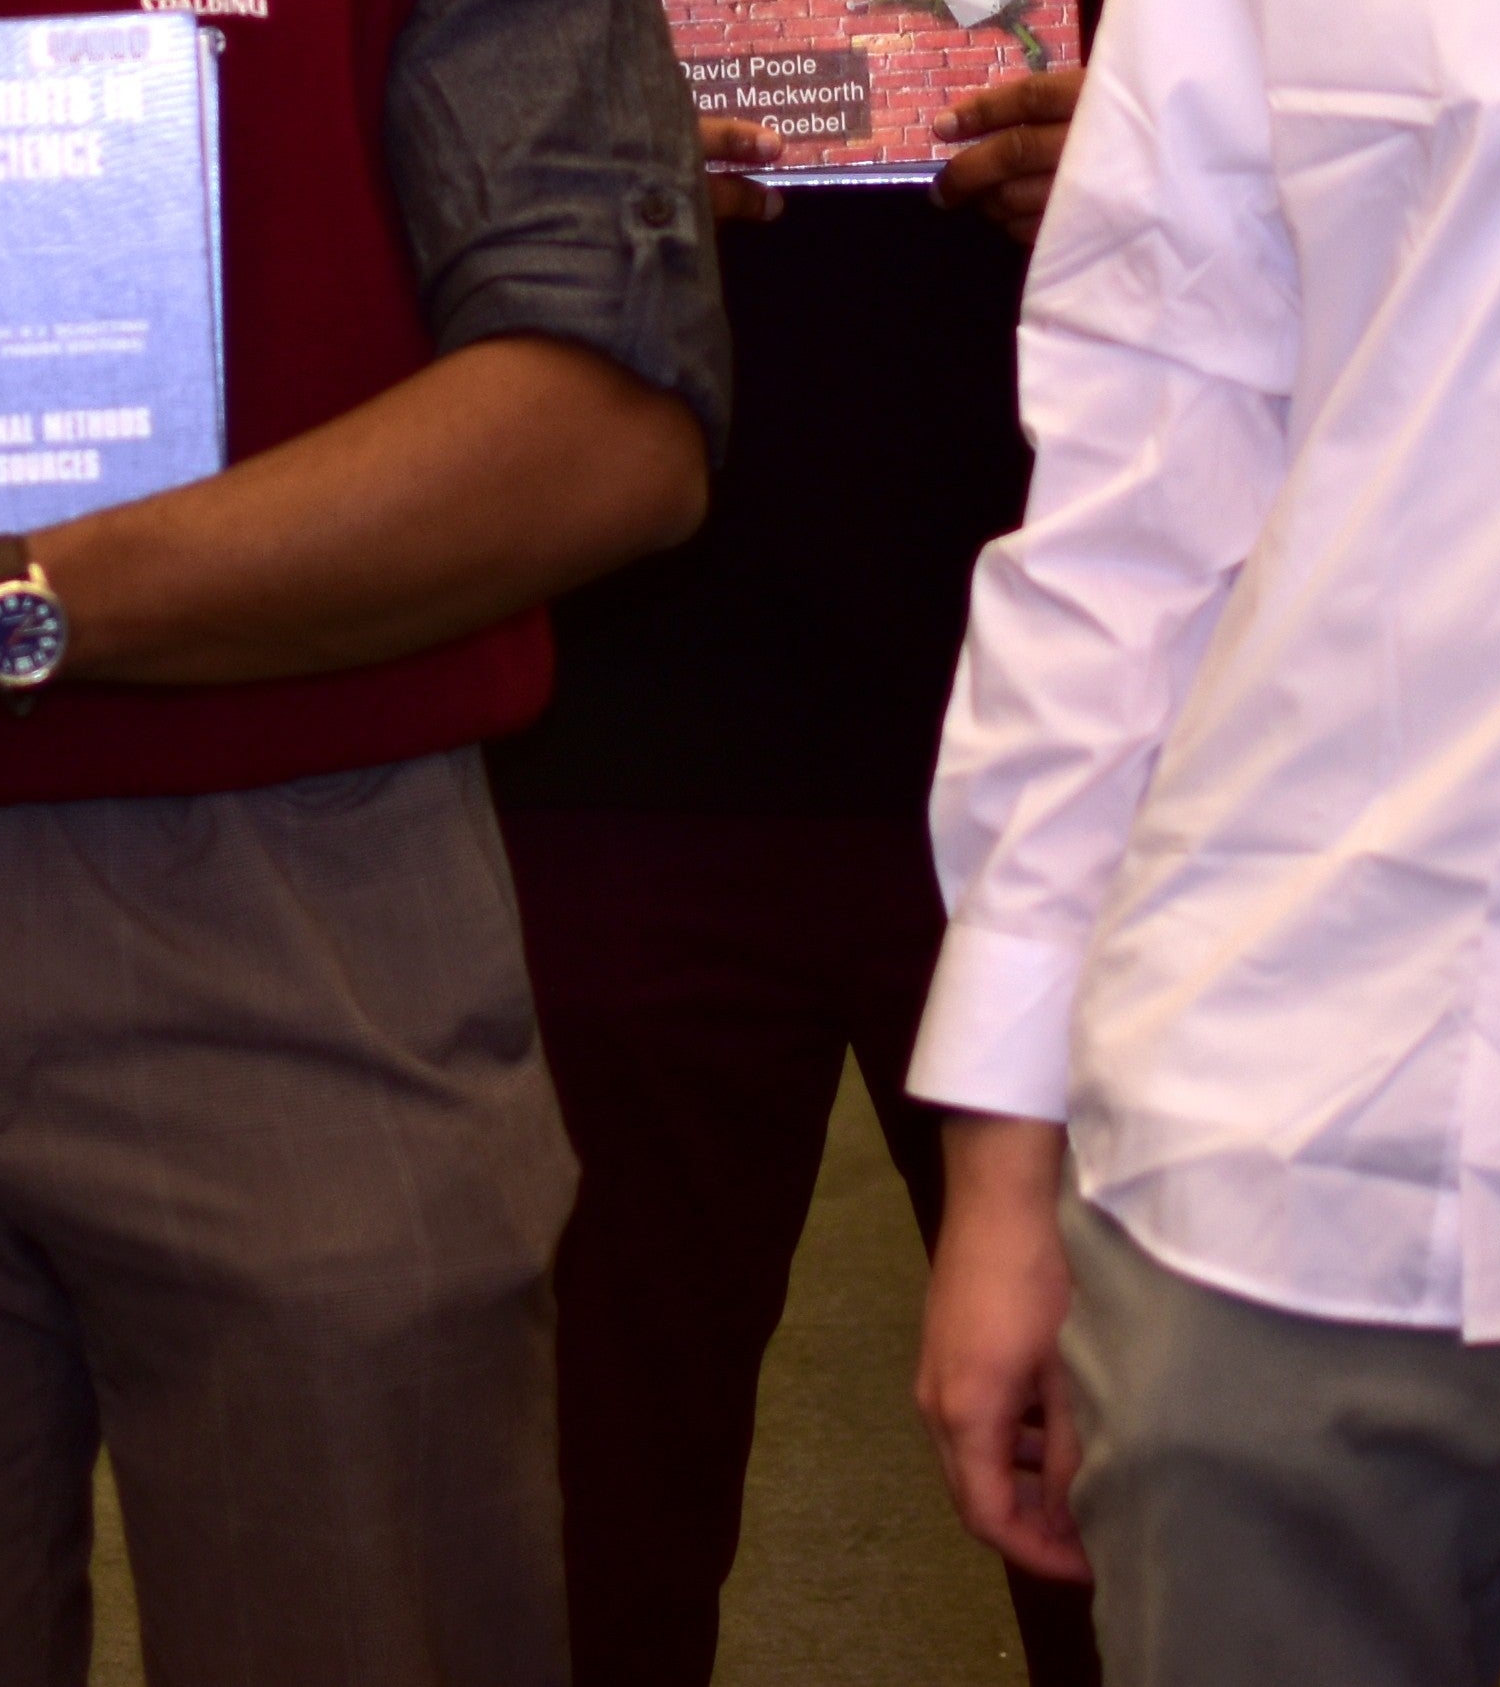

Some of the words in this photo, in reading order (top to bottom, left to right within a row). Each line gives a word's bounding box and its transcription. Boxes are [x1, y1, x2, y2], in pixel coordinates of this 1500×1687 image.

[749, 55, 817, 78] Poole
[691, 90, 728, 110] lan
[736, 81, 865, 108] Mackworth
[760, 111, 847, 136] Goebel
[42, 406, 153, 442] METHODS
